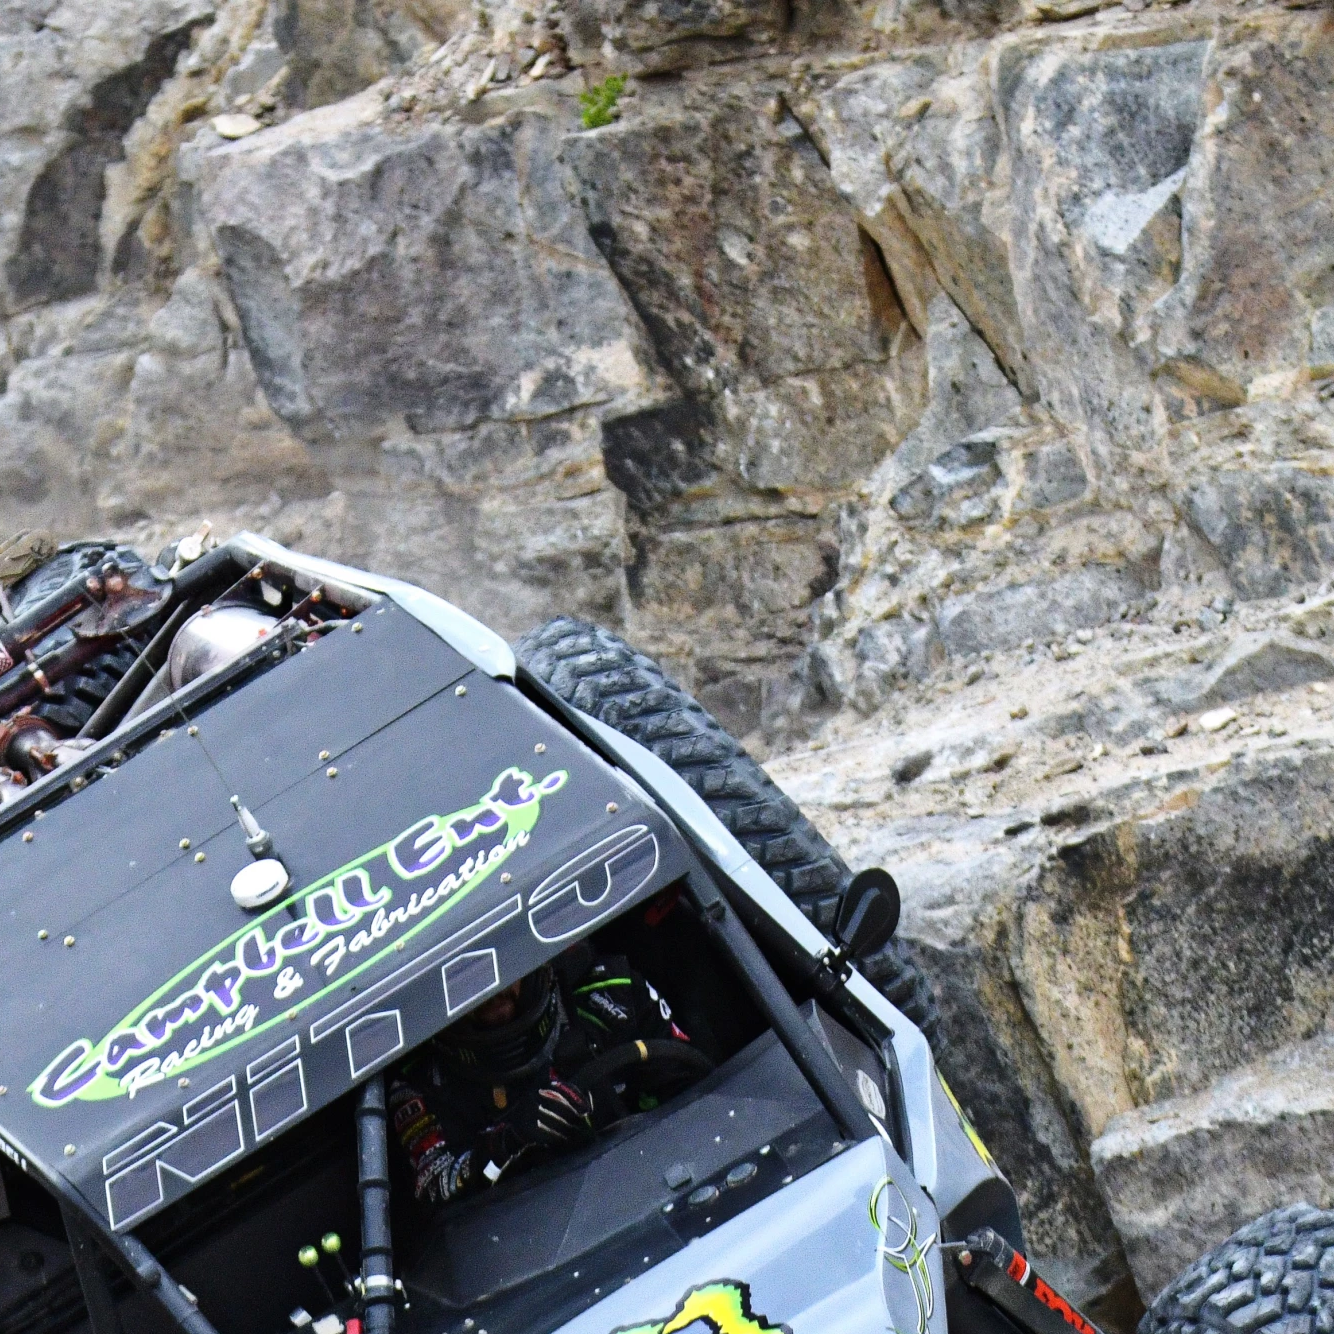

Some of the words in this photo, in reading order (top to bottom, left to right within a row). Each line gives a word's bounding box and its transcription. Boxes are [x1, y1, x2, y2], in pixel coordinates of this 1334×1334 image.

[27, 867, 392, 1107] Campbell
[387, 767, 568, 879] Ent.
[103, 823, 660, 1233] NITTO
[119, 1003, 260, 1098] Racing
[273, 966, 304, 999] &
[310, 828, 531, 976] Fabrication
